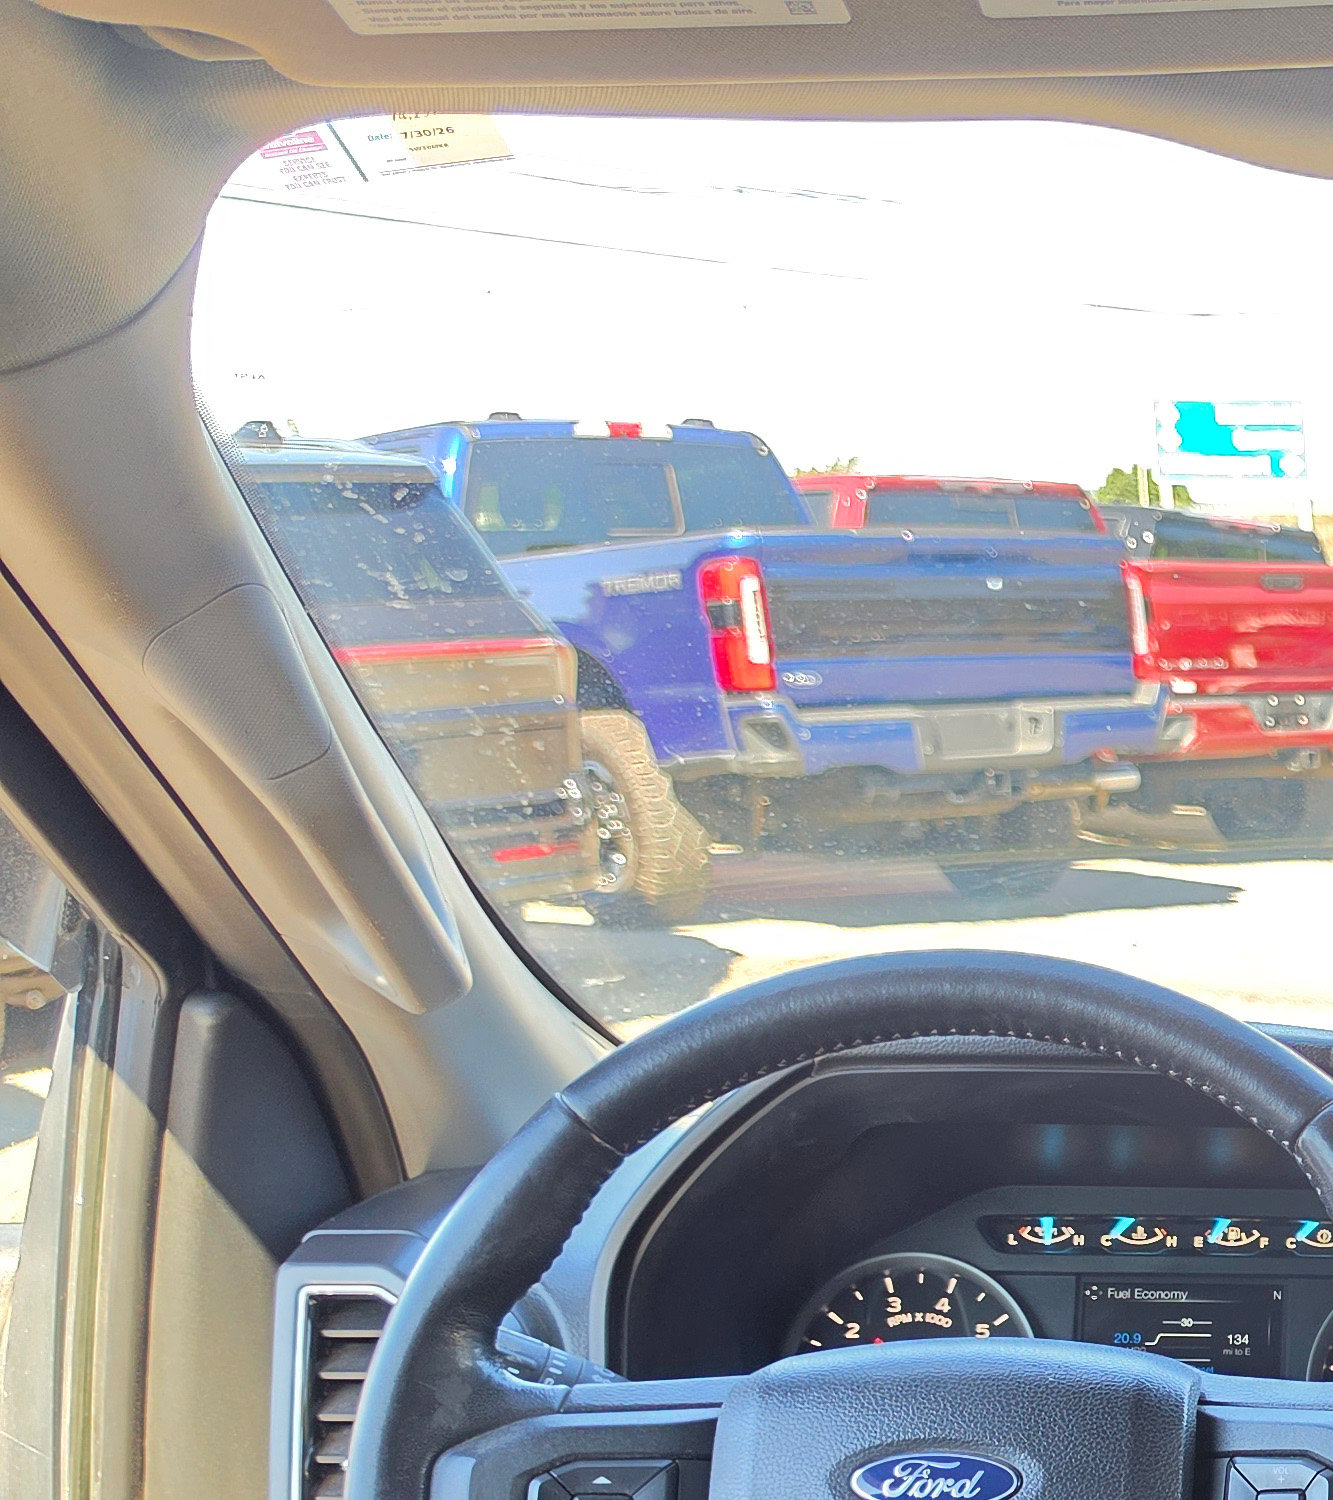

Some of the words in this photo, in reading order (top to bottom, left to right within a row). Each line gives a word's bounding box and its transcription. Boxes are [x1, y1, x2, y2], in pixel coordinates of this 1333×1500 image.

[601, 573, 684, 597] TREMOR
[1007, 1233, 1018, 1245] L
[1073, 1234, 1085, 1246] H
[1166, 1235, 1178, 1248] H
[1193, 1235, 1204, 1247] E
[1259, 1235, 1270, 1249] F
[1107, 1287, 1131, 1299] Fuel
[1134, 1287, 1188, 1302] Economy
[1273, 1290, 1282, 1300] N
[885, 1296, 902, 1313] 3
[934, 1297, 951, 1313] 4
[886, 1312, 913, 1328] RPM
[924, 1312, 953, 1328] 1000
[1180, 1317, 1194, 1328] 30
[844, 1322, 861, 1339] 2
[975, 1323, 990, 1339] 5
[1113, 1332, 1142, 1344] 20.9
[1227, 1334, 1249, 1345] 134
[1222, 1347, 1233, 1356] mi
[1234, 1348, 1243, 1356] to
[1244, 1348, 1251, 1356] E
[1272, 1465, 1290, 1475] VOL
[881, 1458, 985, 1499] Ford
